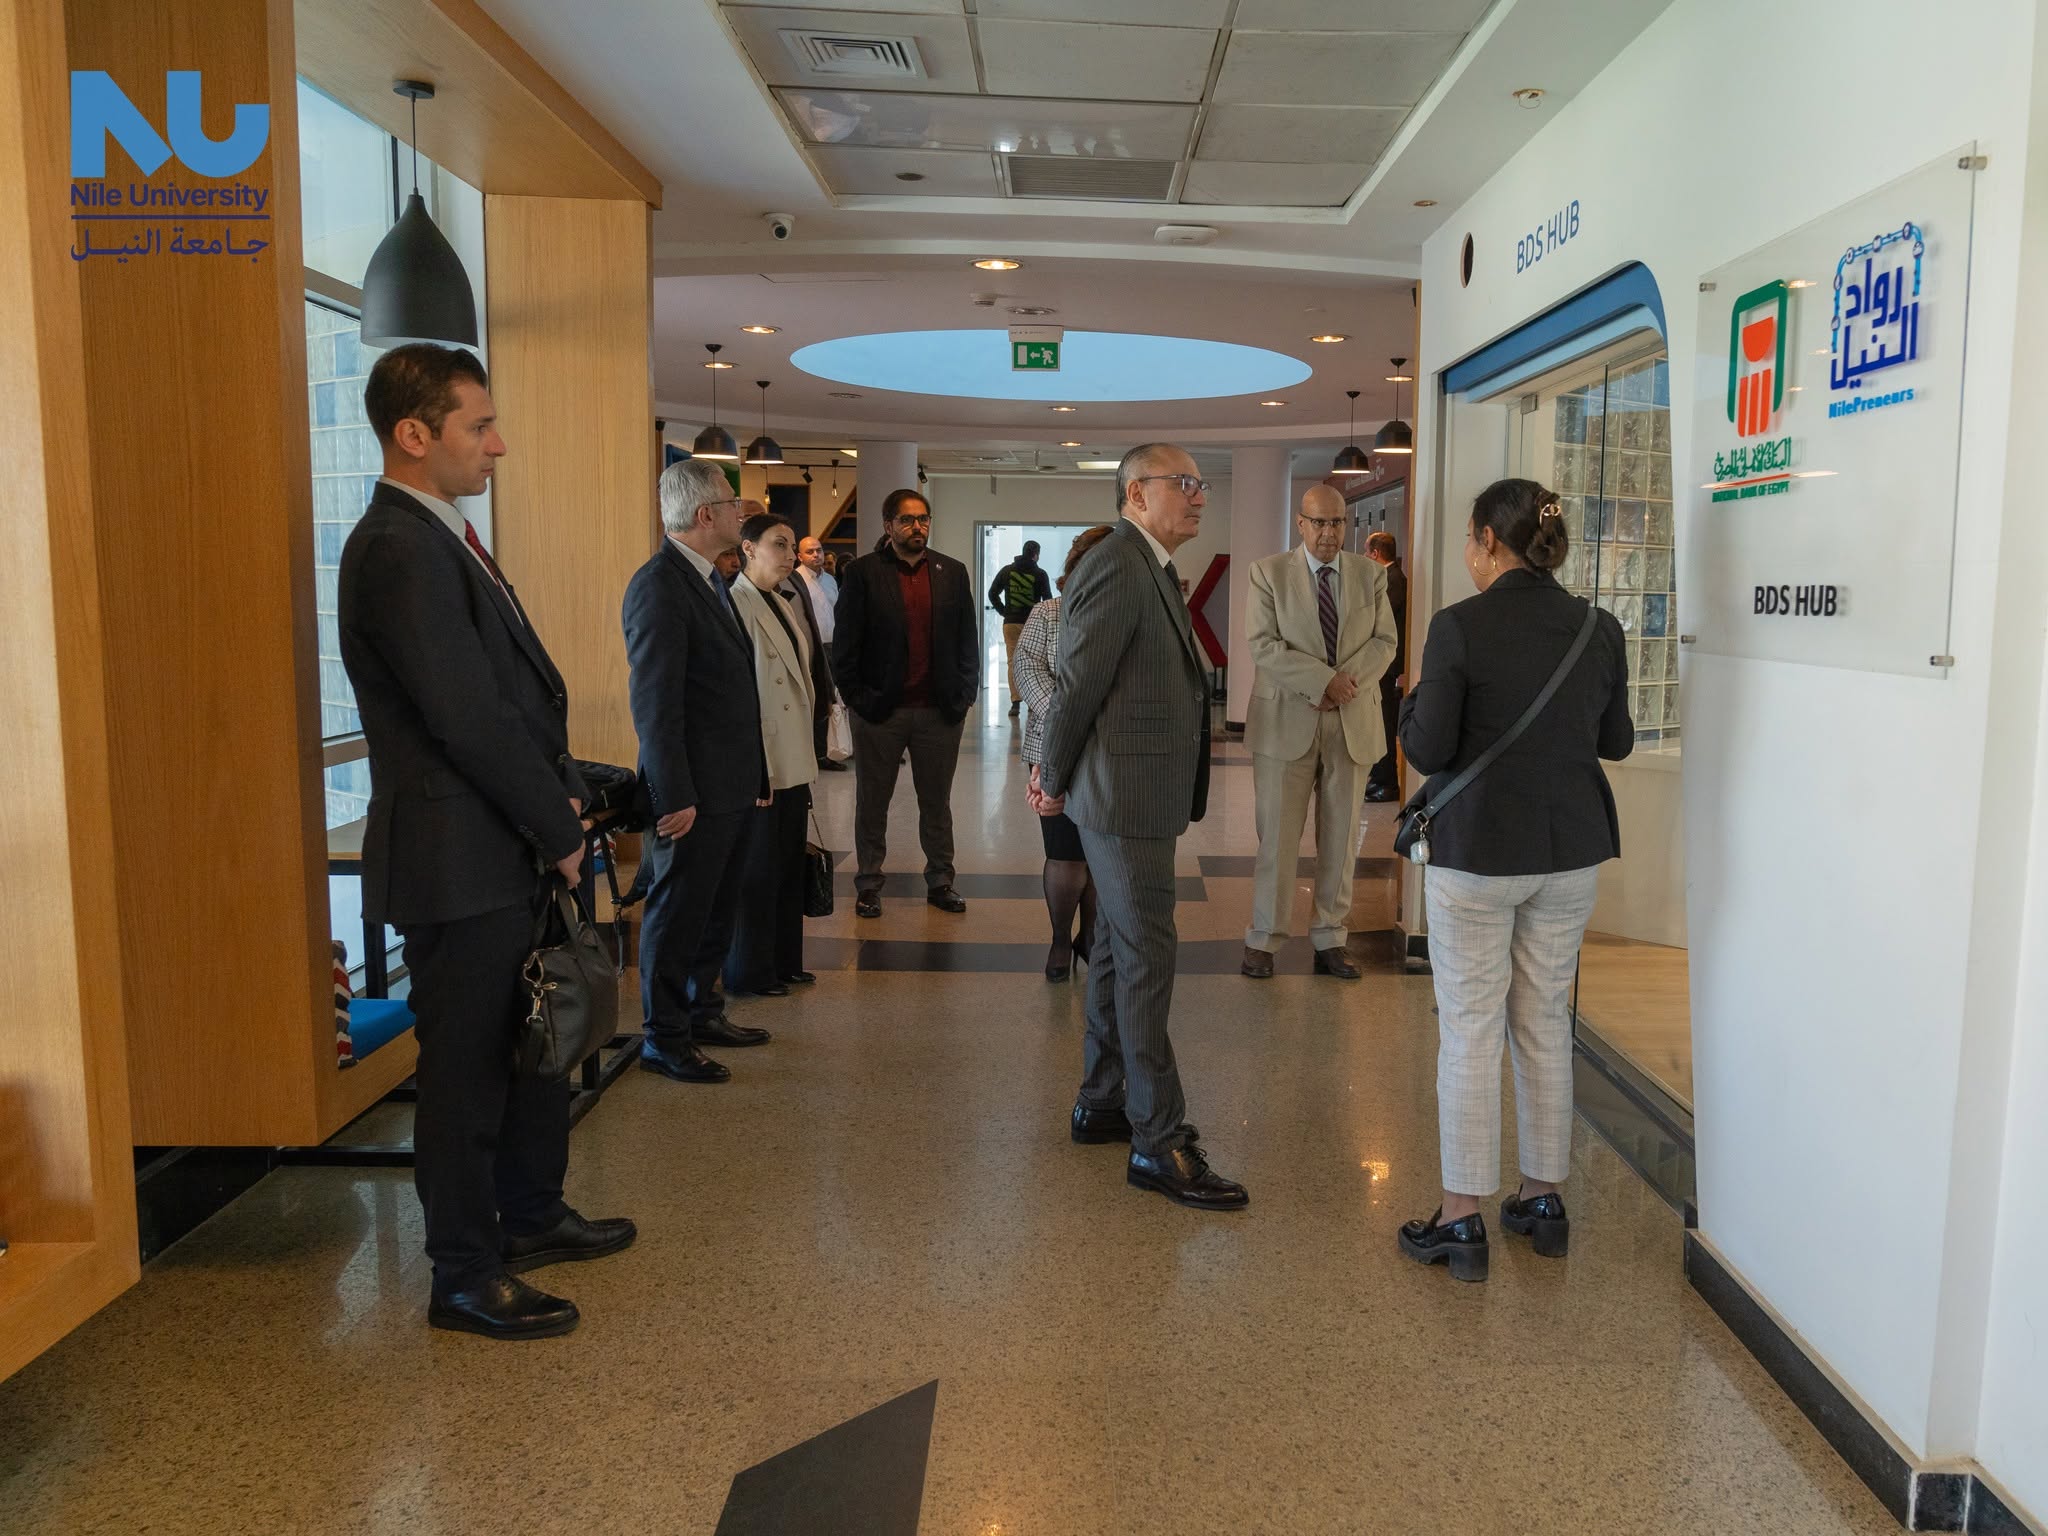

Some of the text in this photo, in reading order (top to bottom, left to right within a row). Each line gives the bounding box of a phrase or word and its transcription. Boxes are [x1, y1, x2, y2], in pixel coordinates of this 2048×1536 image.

[1517, 200, 1580, 274] BDS HUB
[1846, 258, 1904, 329] رواد
[1830, 302, 1919, 390] النيل
[1829, 388, 1915, 418] NilePreneurs
[1758, 483, 1767, 497] OF
[1768, 481, 1790, 495] EGYPT
[1754, 585, 1837, 616] BDS HUB
